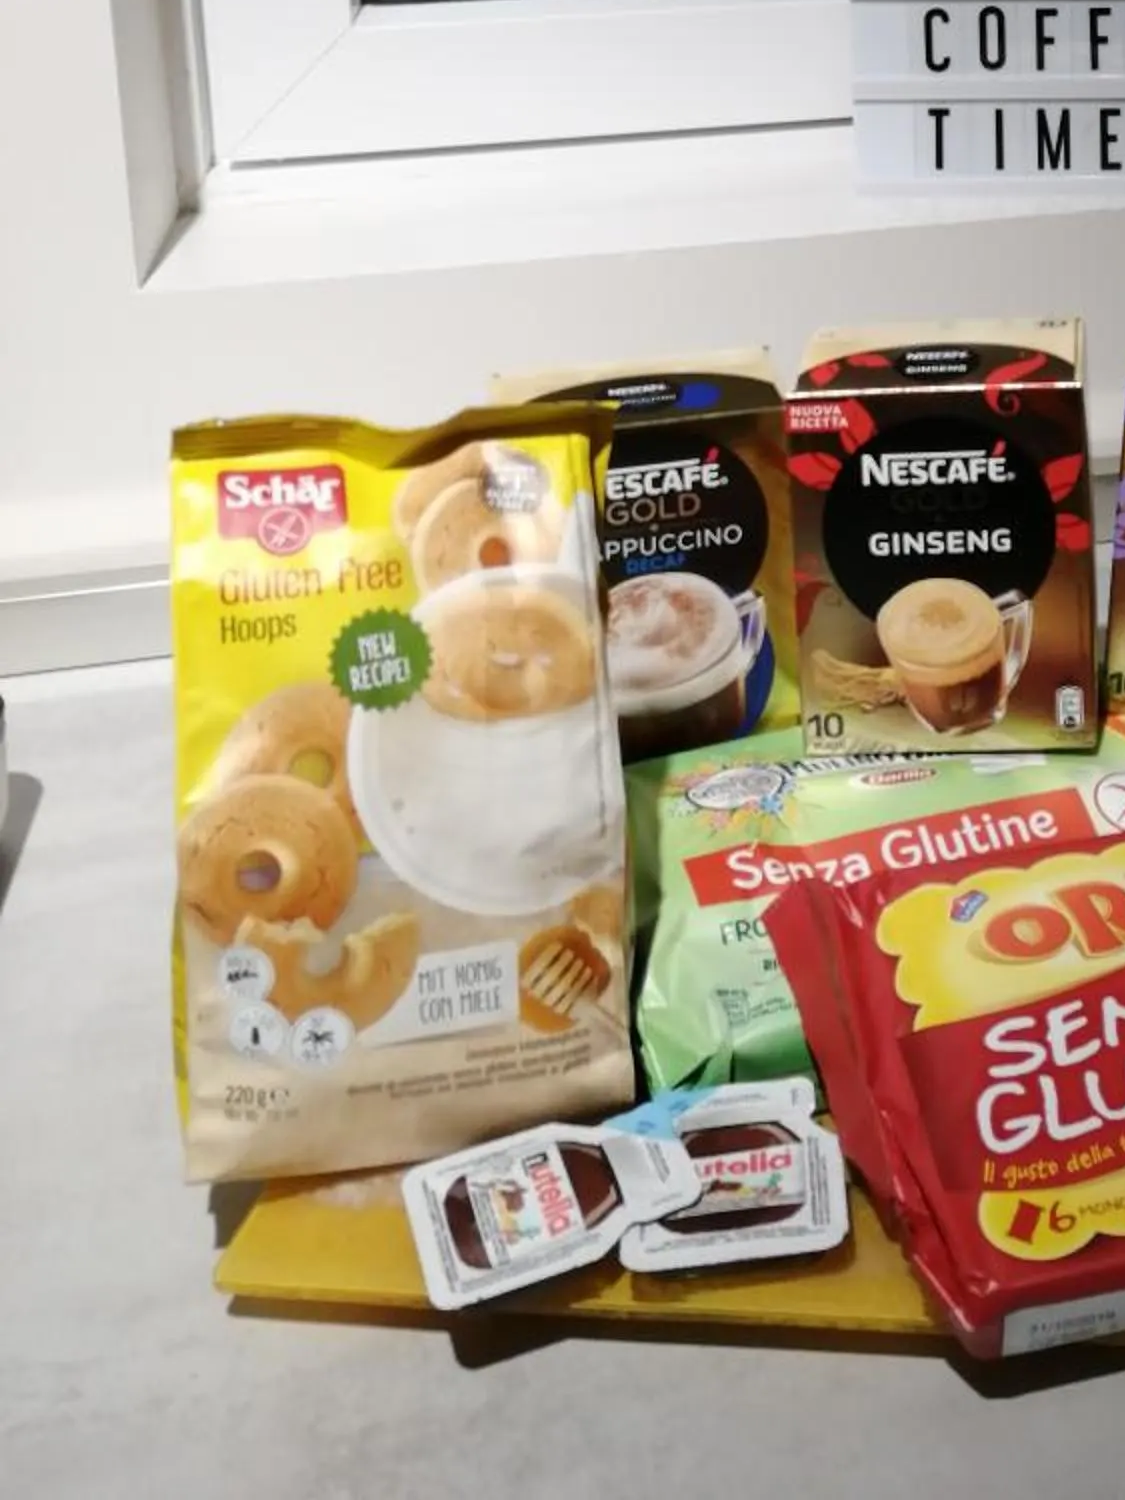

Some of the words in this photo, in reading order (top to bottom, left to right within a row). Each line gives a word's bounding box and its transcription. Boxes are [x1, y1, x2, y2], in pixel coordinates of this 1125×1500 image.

[789, 404, 842, 418] NUOVA
[789, 416, 849, 430] RICETTA
[606, 446, 729, 500] ESCAFÉ
[861, 442, 1015, 487] NESCAFÉ
[223, 473, 341, 511] Schär
[606, 492, 701, 527] GOLD
[598, 525, 743, 563] PPUCCINO
[869, 529, 1012, 557] GINSENG
[218, 564, 322, 607] Gluten
[338, 555, 404, 594] Free
[625, 552, 687, 576] DECAF
[219, 612, 298, 646] Hoops
[357, 631, 397, 654] NEW
[349, 656, 411, 693] RECIPE!
[808, 712, 845, 738] 10
[726, 850, 872, 889] Senza
[881, 808, 1060, 871] Glutine
[417, 965, 450, 995] MIT
[418, 998, 454, 1026] CON
[459, 989, 502, 1016] MIELE
[224, 1085, 255, 1105] 220
[695, 1150, 793, 1178] utella
[983, 1159, 995, 1184] Il
[1003, 1156, 1059, 1189] gusto
[1066, 1145, 1115, 1174] della
[522, 1151, 573, 1236] nutella
[1049, 1200, 1077, 1234] 6
